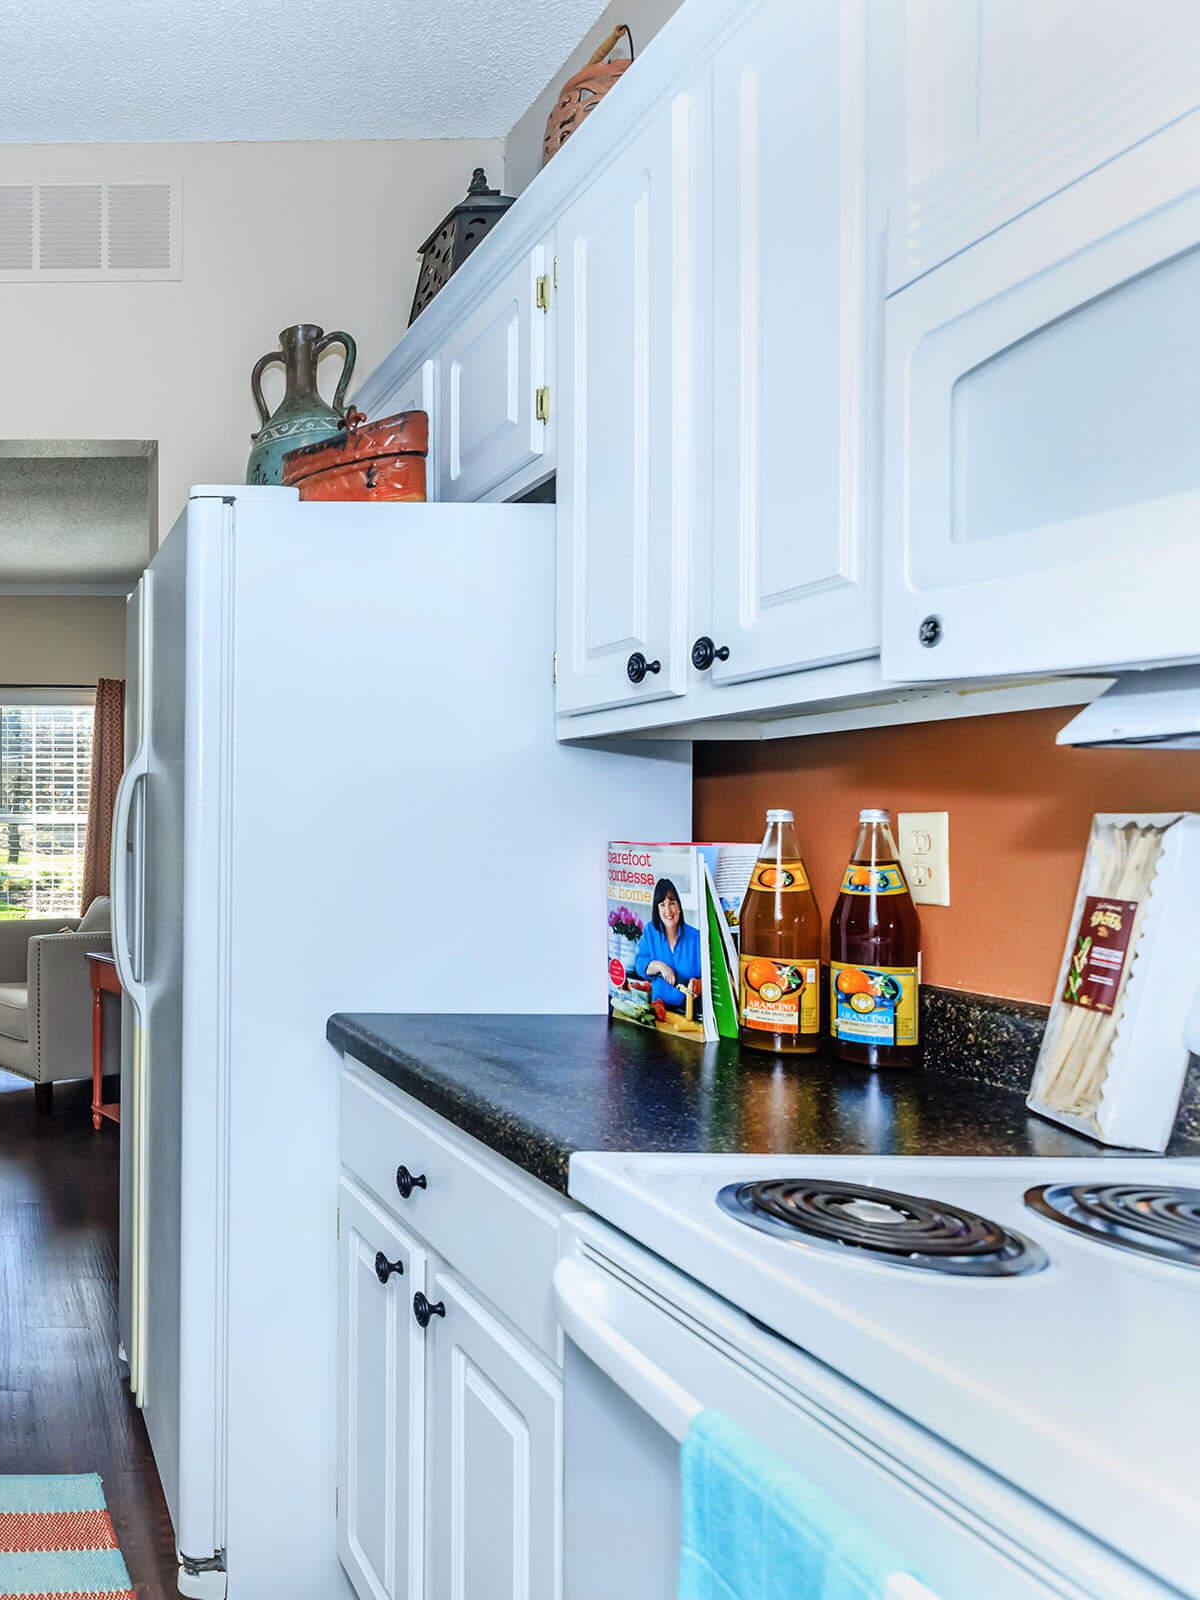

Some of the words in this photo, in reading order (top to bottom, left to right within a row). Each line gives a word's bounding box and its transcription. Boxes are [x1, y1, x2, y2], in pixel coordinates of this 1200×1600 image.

[618, 886, 652, 903] home
[749, 1000, 796, 1011] ARANCINO
[840, 1011, 891, 1023] ARANCINO
